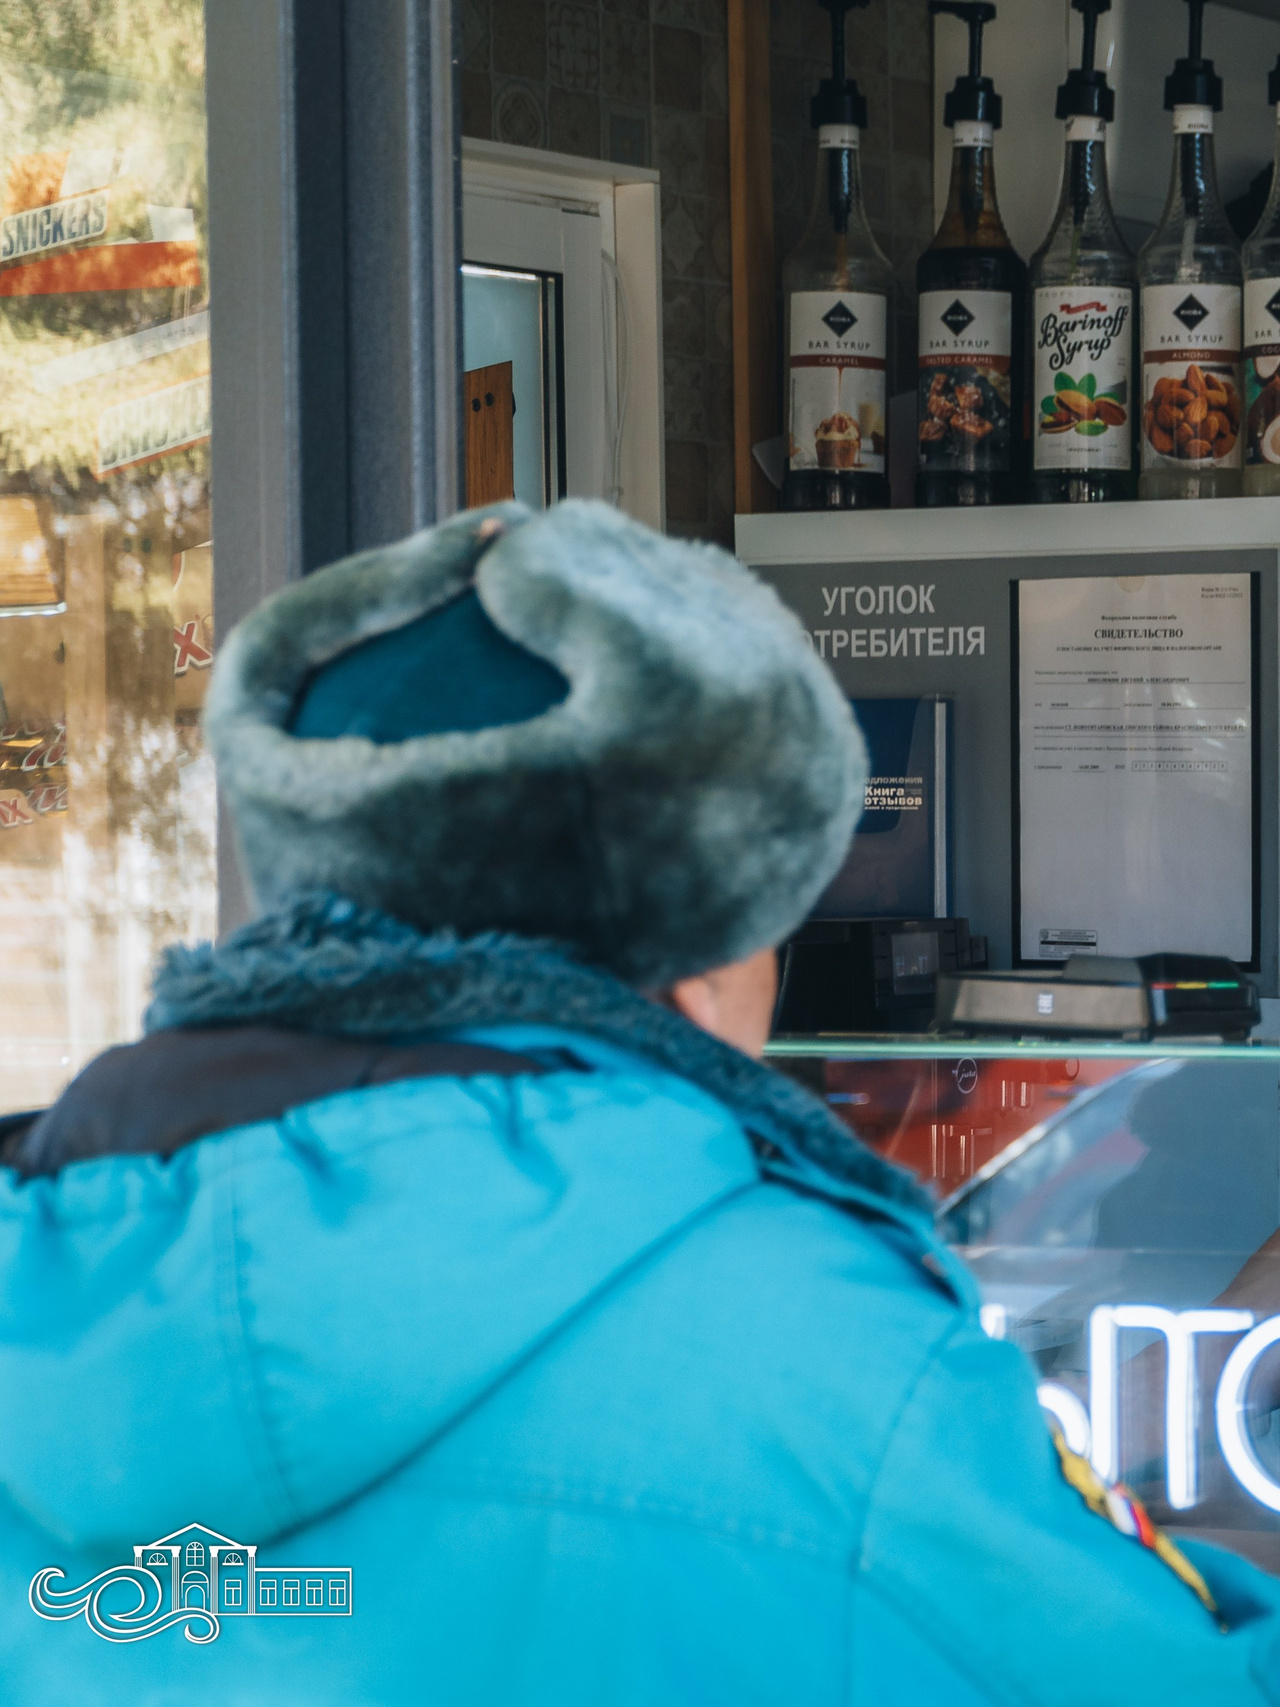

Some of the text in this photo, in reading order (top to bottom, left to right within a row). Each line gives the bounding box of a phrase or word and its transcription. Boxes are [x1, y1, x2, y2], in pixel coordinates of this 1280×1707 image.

[2, 196, 106, 257] SNICKERS
[1038, 305, 1129, 350] Barinoff
[1160, 334, 1224, 343] BAR SYRUP
[1254, 329, 1272, 338] BAR
[808, 340, 871, 351] BAR SYRUP
[929, 339, 990, 349] BAR SYRUP
[1049, 334, 1112, 371] Syrup
[1171, 351, 1211, 360] ALMOND
[818, 356, 860, 366] CARAMEL
[954, 356, 993, 365] CARAMEL
[821, 584, 936, 617] УГОЛОК
[1094, 628, 1184, 639] СВИДЕТЕЛЬСТВО
[864, 786, 905, 796] Книга
[864, 797, 923, 806] отзывов
